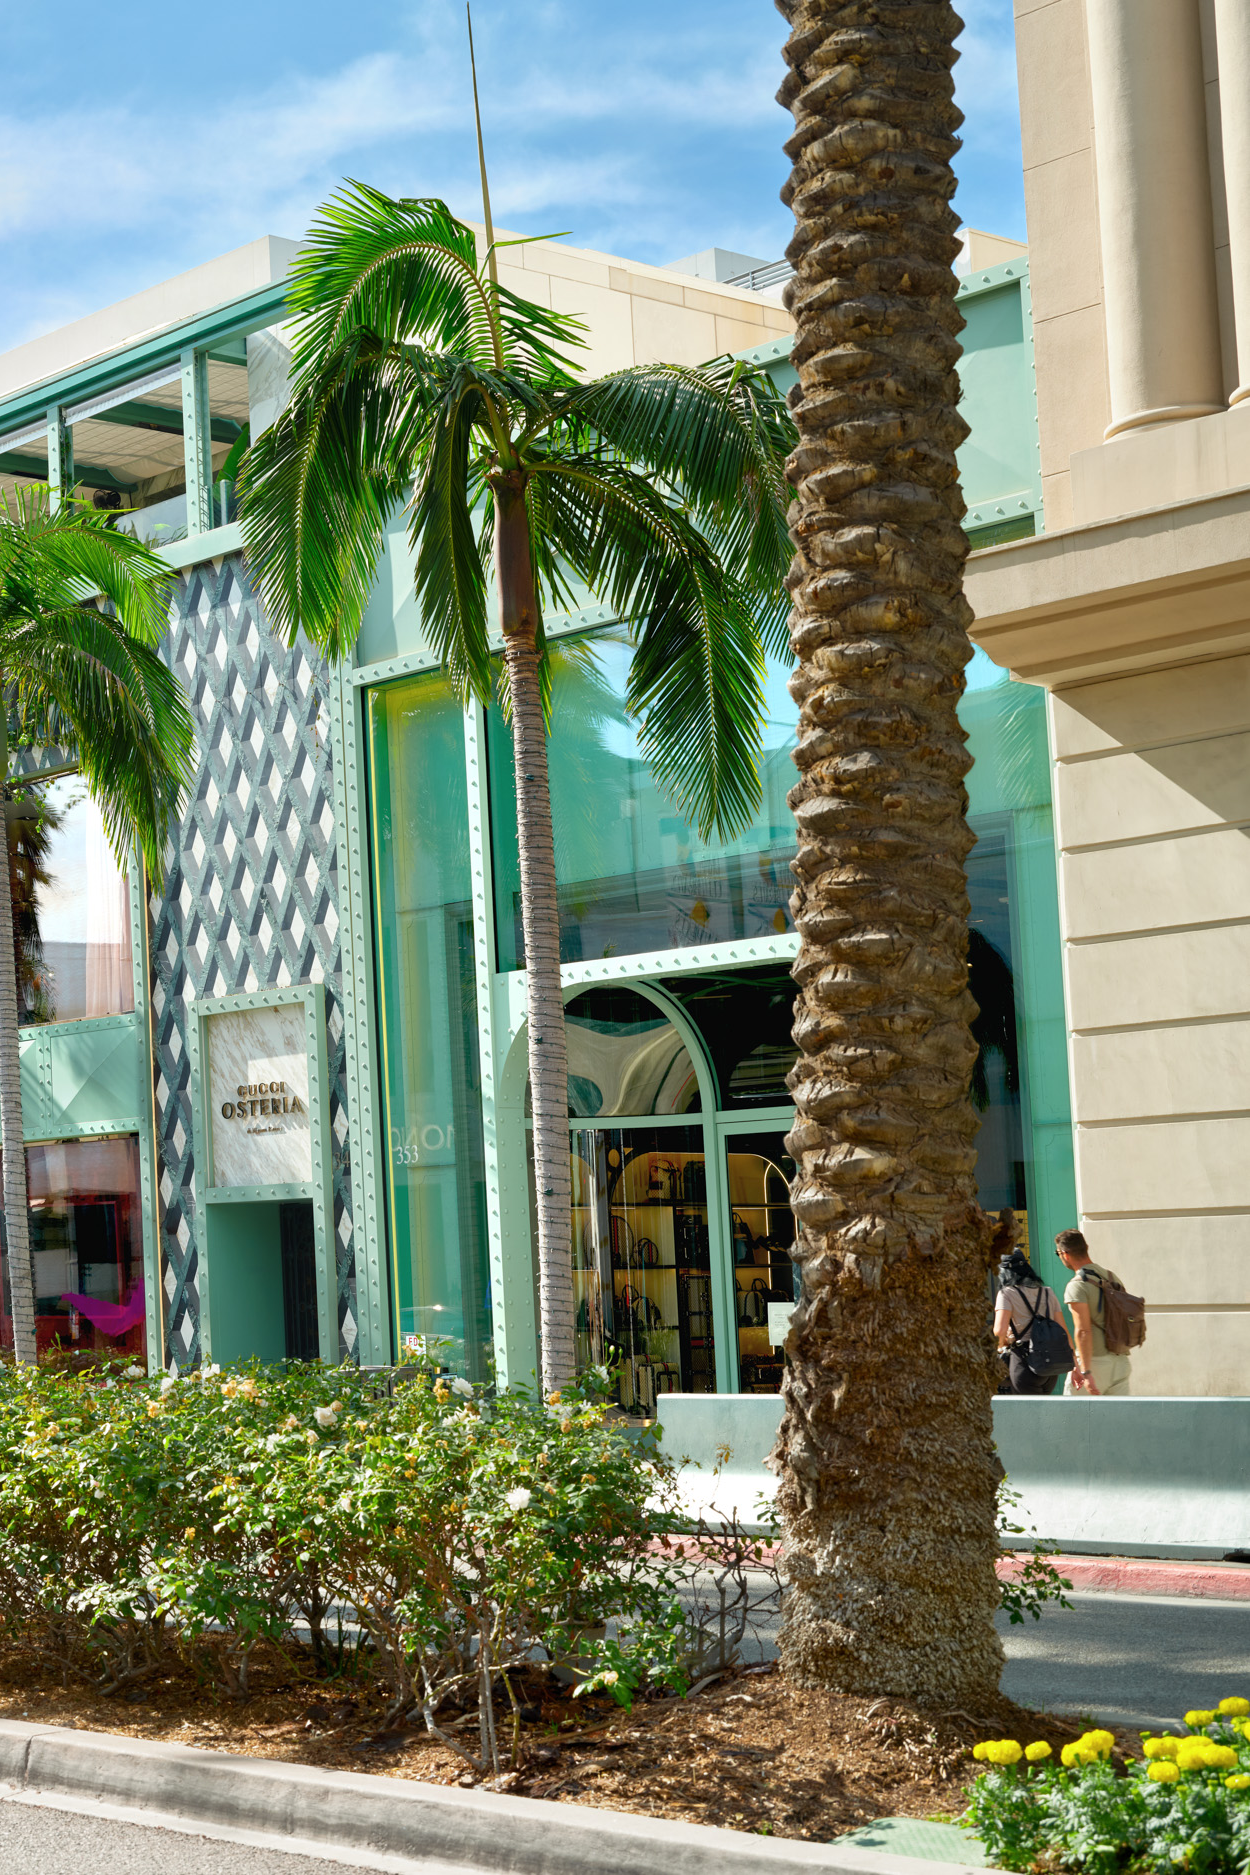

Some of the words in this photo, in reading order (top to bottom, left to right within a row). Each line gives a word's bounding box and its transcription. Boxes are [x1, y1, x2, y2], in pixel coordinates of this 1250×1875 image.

[237, 1081, 285, 1097] GUCCI
[221, 1095, 306, 1119] OSTERIA
[333, 1150, 350, 1170] 34
[396, 1144, 419, 1165] 353
[408, 1337, 422, 1347] FD
